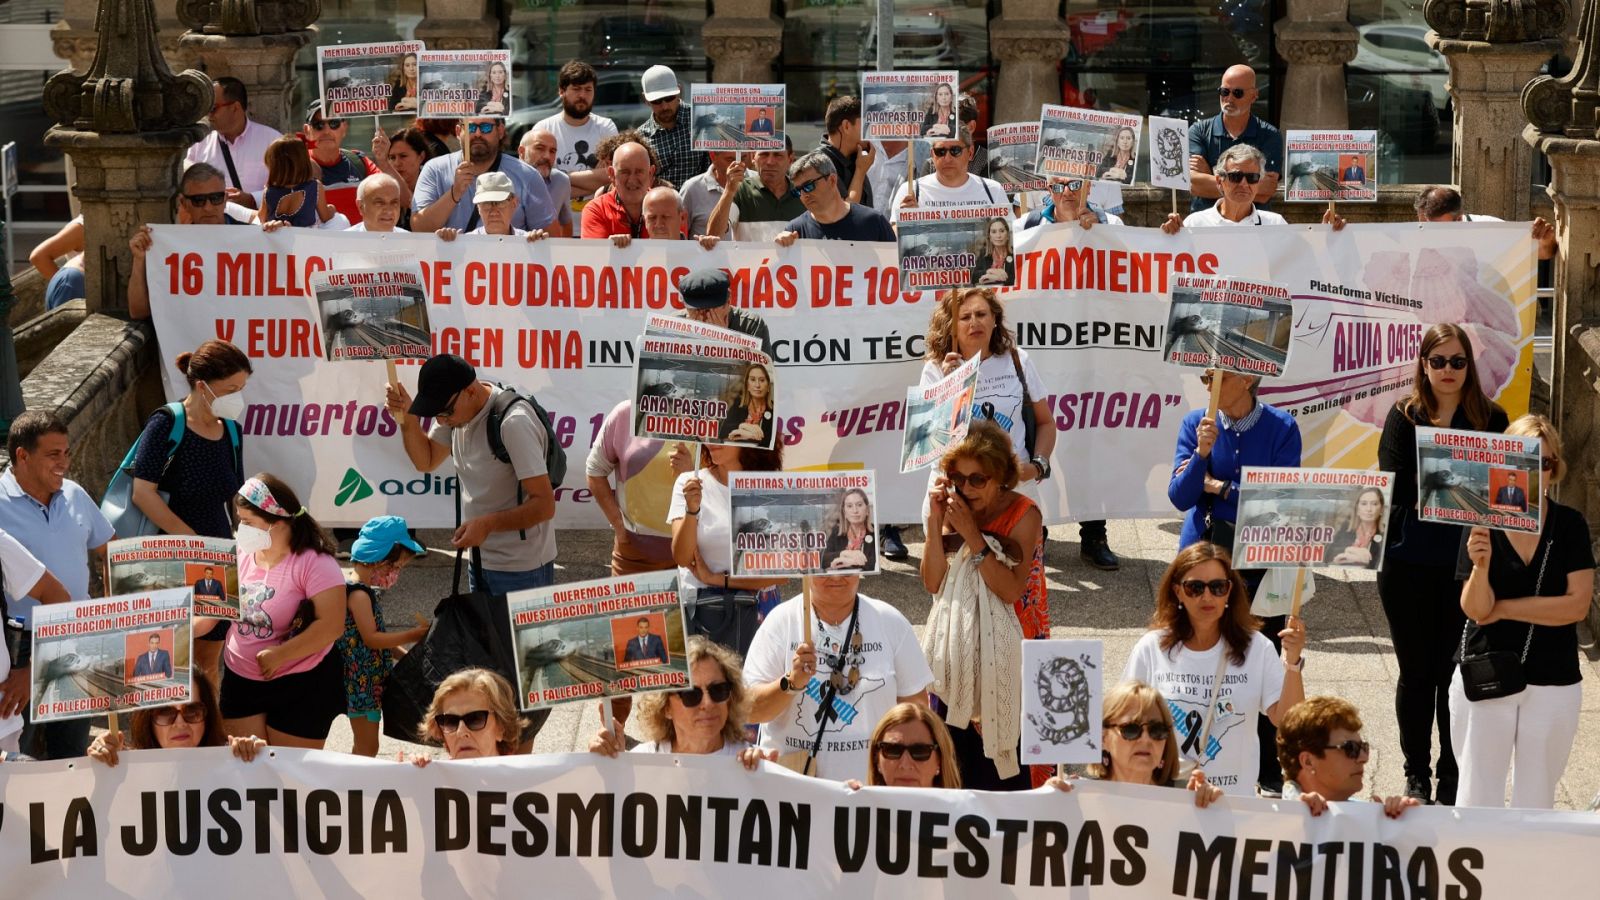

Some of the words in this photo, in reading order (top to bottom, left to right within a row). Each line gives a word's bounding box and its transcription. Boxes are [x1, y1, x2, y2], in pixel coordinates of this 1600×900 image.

[324, 47, 360, 58] MENTIRAS
[369, 44, 419, 55] OCULTACIONES
[421, 54, 452, 62] MENTIRAS
[906, 74, 954, 82] OCULTACIONES
[328, 88, 349, 100] ANA
[353, 85, 392, 98] PASTOR
[422, 90, 441, 100] ANA
[444, 90, 479, 100] PASTOR
[866, 112, 886, 122] ANA
[887, 112, 925, 122] PASTOR
[1046, 109, 1081, 120] MENTIRAS
[1089, 114, 1138, 126] OCULTACIONES
[1042, 146, 1062, 158] ANA
[1065, 148, 1102, 163] PASTOR
[900, 211, 941, 221] MENTIRAS
[951, 208, 1008, 218] OCULTACIONES
[903, 256, 926, 269] ANA
[931, 254, 976, 268] PASTOR
[164, 252, 204, 296] 16
[216, 252, 332, 297] MILLO
[719, 258, 798, 310] MÁS
[811, 265, 852, 308] DE
[328, 274, 344, 286] WE
[347, 272, 375, 284] WANT
[378, 272, 390, 283] TO
[393, 272, 416, 284] KNOW
[1178, 277, 1190, 288] WE
[1192, 278, 1214, 289] WANT
[1216, 279, 1228, 290] AN
[352, 286, 370, 298] THE
[372, 285, 404, 296] TRUTH
[1200, 290, 1264, 306] INVESTIGATION
[1310, 279, 1372, 301] Plataforma
[1375, 291, 1423, 310] Víctimas
[651, 317, 692, 332] MENTIRAS
[701, 327, 756, 349] OCULTACIONES
[334, 347, 344, 358] 81
[347, 346, 374, 357] DEADS
[385, 344, 400, 356] 140
[518, 329, 583, 370] UNA
[644, 340, 692, 354] MENTIRAS
[696, 345, 701, 354] Y
[704, 346, 768, 365] OCULTACIONES
[1333, 320, 1382, 374] ALVIA
[1386, 324, 1422, 365] 04155
[1183, 352, 1208, 364] DEADS
[1220, 353, 1235, 366] 140
[1237, 356, 1277, 374] INJURED
[1302, 394, 1352, 416] Santiago
[1355, 388, 1368, 401] de
[1370, 376, 1414, 398] Composte
[640, 395, 668, 413] ANA
[674, 398, 727, 418] PASTOR
[242, 400, 397, 438] muertos
[1434, 433, 1488, 449] QUEREMOS
[1492, 438, 1524, 453] SABER
[1453, 448, 1464, 460] LA
[1468, 450, 1505, 464] VERDAD
[380, 473, 456, 496] adif
[735, 478, 784, 489] MENTIRAS
[788, 478, 792, 488] Y
[796, 476, 868, 488] OCULTACIONES
[1247, 472, 1299, 483] MENTIRAS
[1303, 472, 1309, 482] Y
[1312, 472, 1388, 487] OCULTACIONES
[1424, 507, 1432, 516] 81
[1434, 508, 1477, 521] FALLECIDOS
[1504, 516, 1536, 529] HERIDOS
[738, 532, 766, 550] ANA
[770, 532, 826, 548] PASTOR
[1240, 526, 1270, 543] ANA
[1276, 526, 1334, 543] PASTOR
[142, 540, 187, 549] QUEREMOS
[190, 540, 205, 549] UNA
[112, 550, 174, 562] INVESTIGACION
[175, 550, 235, 562] INDEPENDIENTE
[554, 584, 611, 604] QUEREMOS
[614, 581, 635, 594] UNA
[76, 601, 130, 619] QUEREMOS
[132, 598, 152, 610] UNA
[204, 604, 238, 616] HERIDOS
[515, 604, 595, 626] INVESTIGACION
[598, 592, 678, 613] INDEPENDIENTE
[37, 619, 112, 638] INVESTIGACION
[114, 608, 188, 628] INDEPENDIENTE
[1166, 672, 1200, 684] MUERTOS
[529, 692, 540, 704] 81
[543, 682, 603, 702] FALLECIDOS
[619, 678, 637, 690] 140
[640, 672, 685, 688] HERIDOS
[1185, 686, 1198, 696] DE
[38, 704, 49, 715] 81
[52, 696, 110, 714] FALLECIDOS
[124, 692, 140, 704] 140
[144, 686, 185, 701] HERIDOS
[785, 736, 823, 752] SIEMPRE
[827, 738, 870, 752] PRESENT
[29, 796, 98, 864] LA
[120, 788, 408, 856] JUSTICIA
[434, 787, 812, 870] DESMONTAN
[834, 806, 1150, 887] VUESTRAS
[1172, 831, 1486, 900] MENTIRAS
